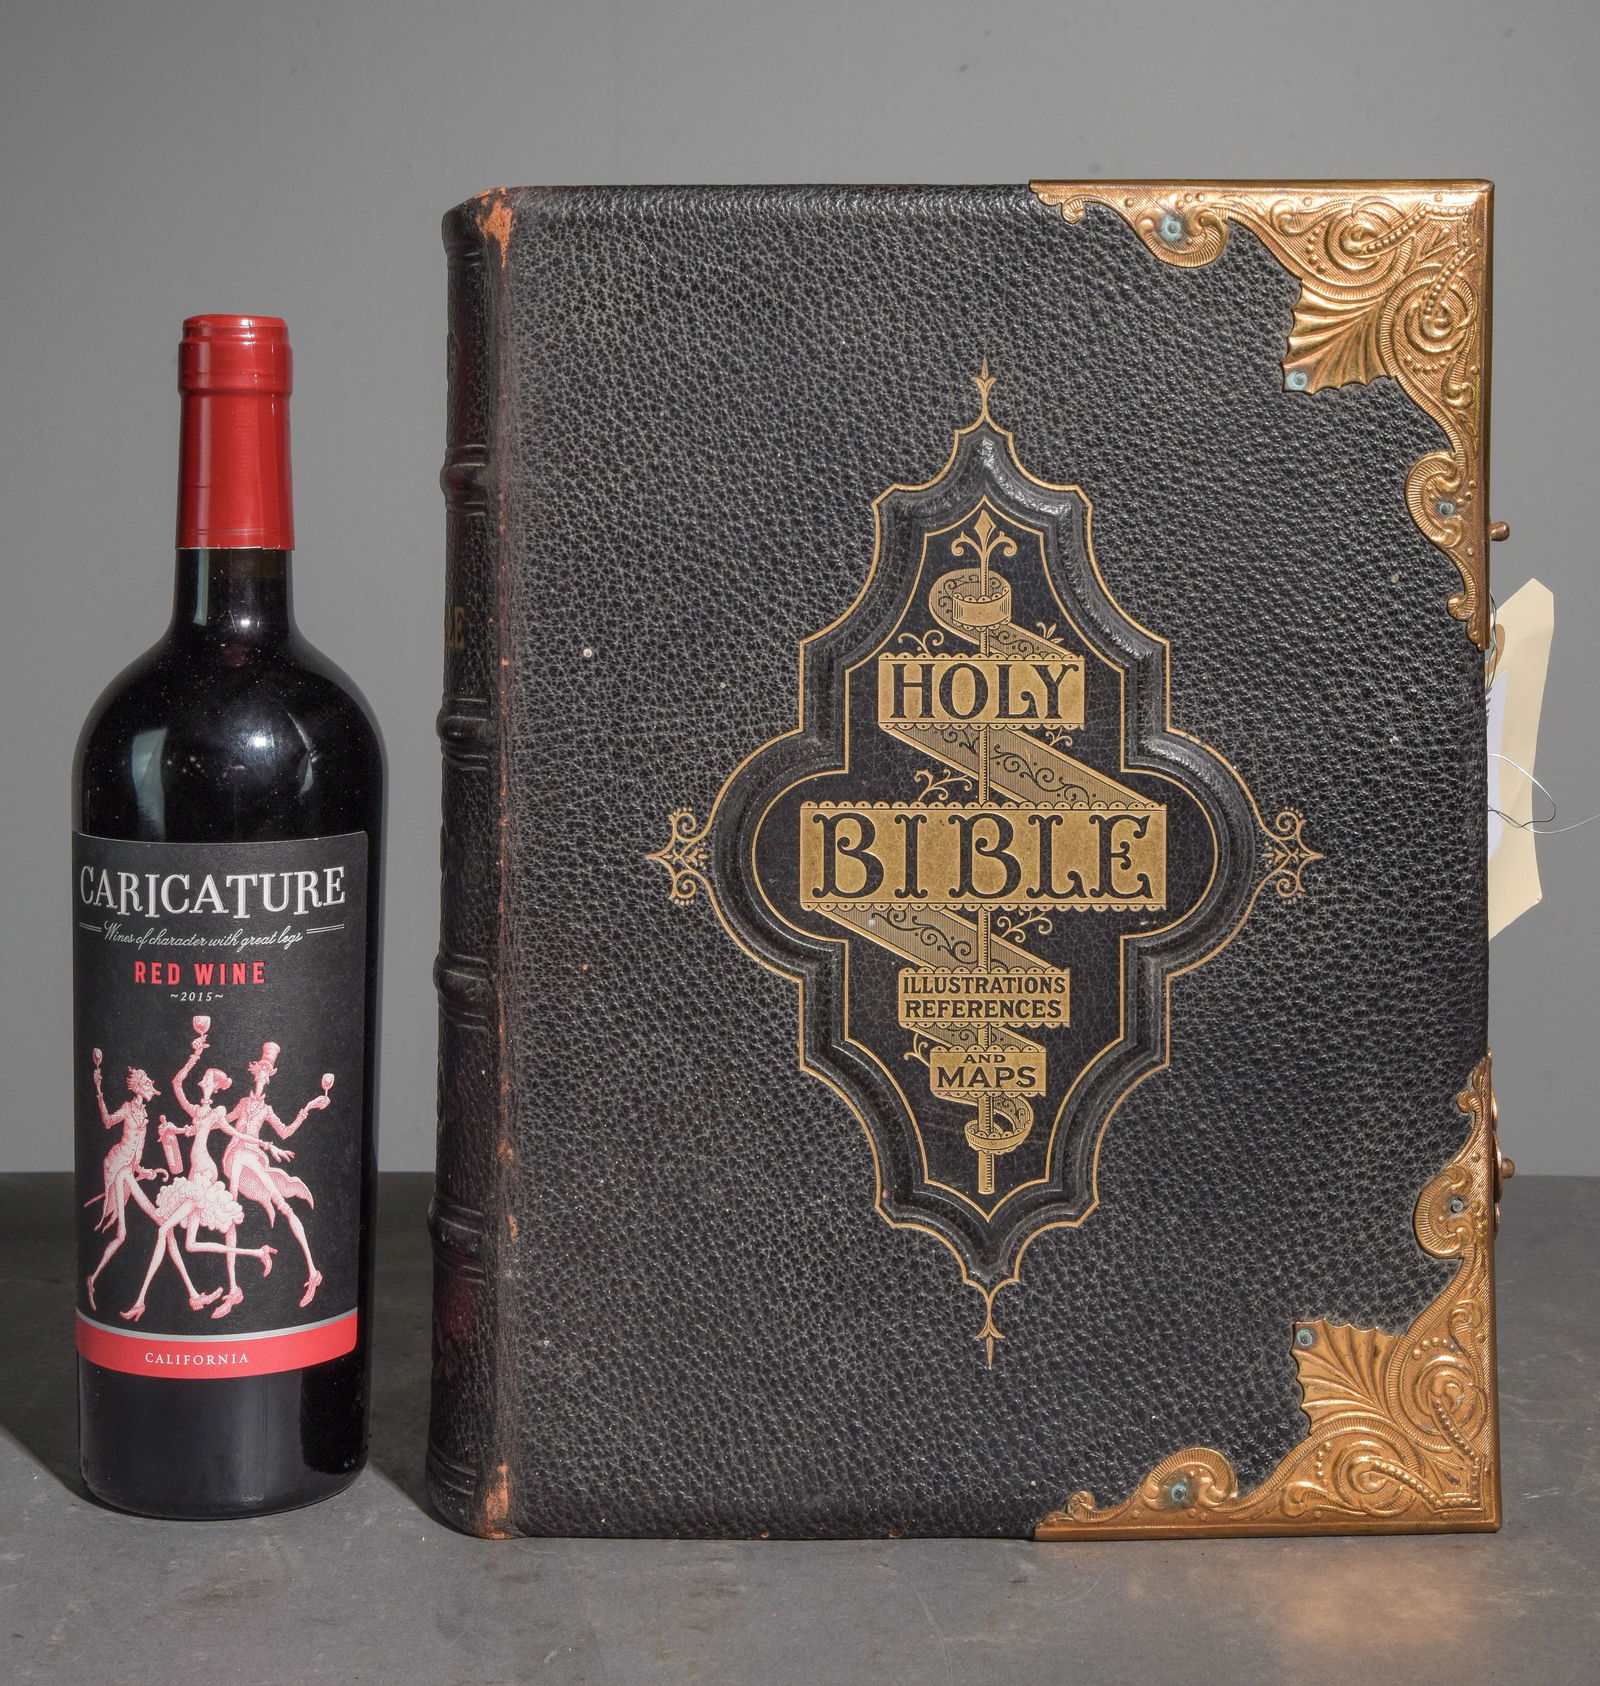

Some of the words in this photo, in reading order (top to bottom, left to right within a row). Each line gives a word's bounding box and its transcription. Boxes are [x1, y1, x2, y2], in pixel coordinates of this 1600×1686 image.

[889, 663, 1080, 720] HOLY
[812, 812, 1153, 900] BIBLE
[80, 865, 346, 919] CARICATURE
[104, 920, 134, 943] Wines
[135, 928, 154, 950] of
[149, 928, 207, 947] character
[208, 928, 243, 947] with
[236, 931, 277, 953] great
[277, 925, 303, 950] legs
[134, 961, 181, 986] RED
[194, 961, 266, 986] WINE
[903, 976, 1066, 995] ILLUSTRATIONS
[905, 999, 1062, 1018] REFERENCES
[963, 1053, 1007, 1064] AND
[936, 1066, 1037, 1088] MAPS
[145, 1352, 249, 1366] CALIFORNIA
